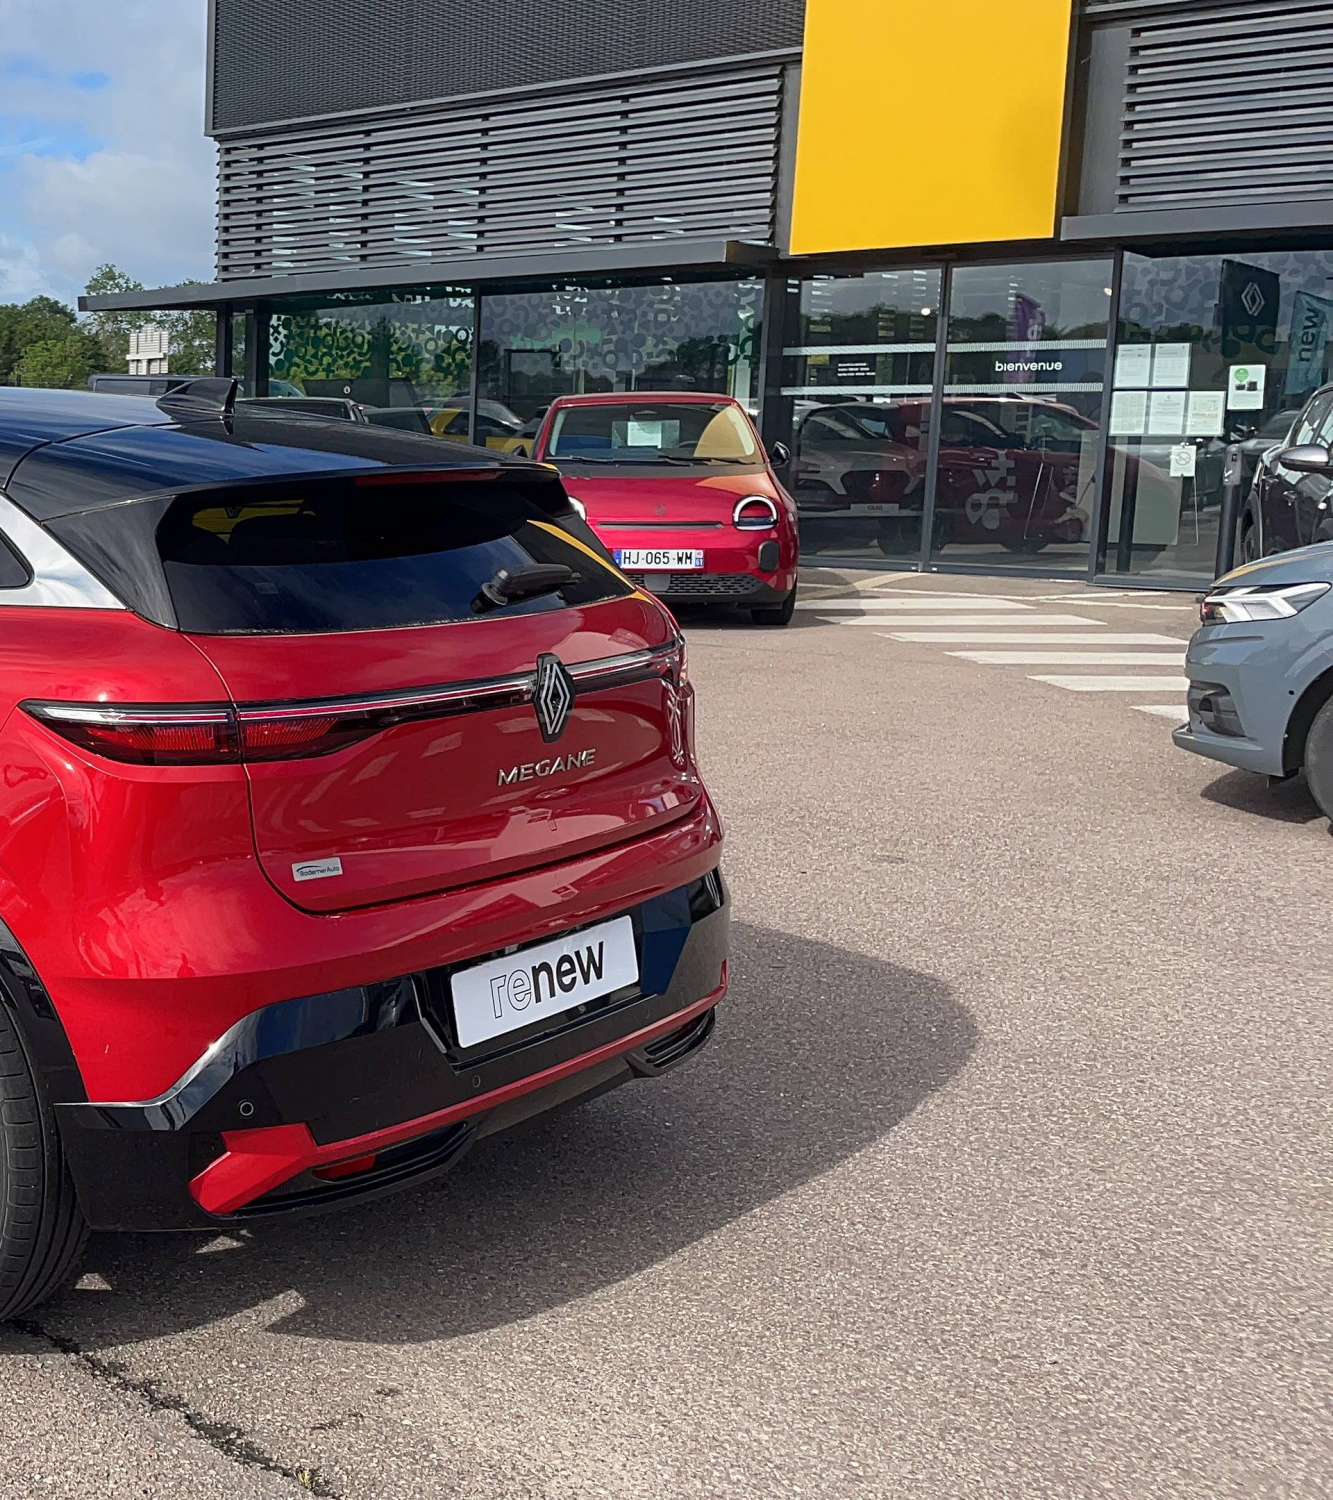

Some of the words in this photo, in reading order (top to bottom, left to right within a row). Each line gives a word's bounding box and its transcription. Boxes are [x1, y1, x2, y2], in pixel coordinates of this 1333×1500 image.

[1297, 307, 1320, 362] new
[995, 360, 1063, 372] bienvenue
[623, 551, 693, 566] HJ-065-WM
[497, 748, 596, 787] MEGANE
[490, 940, 604, 1019] renew
